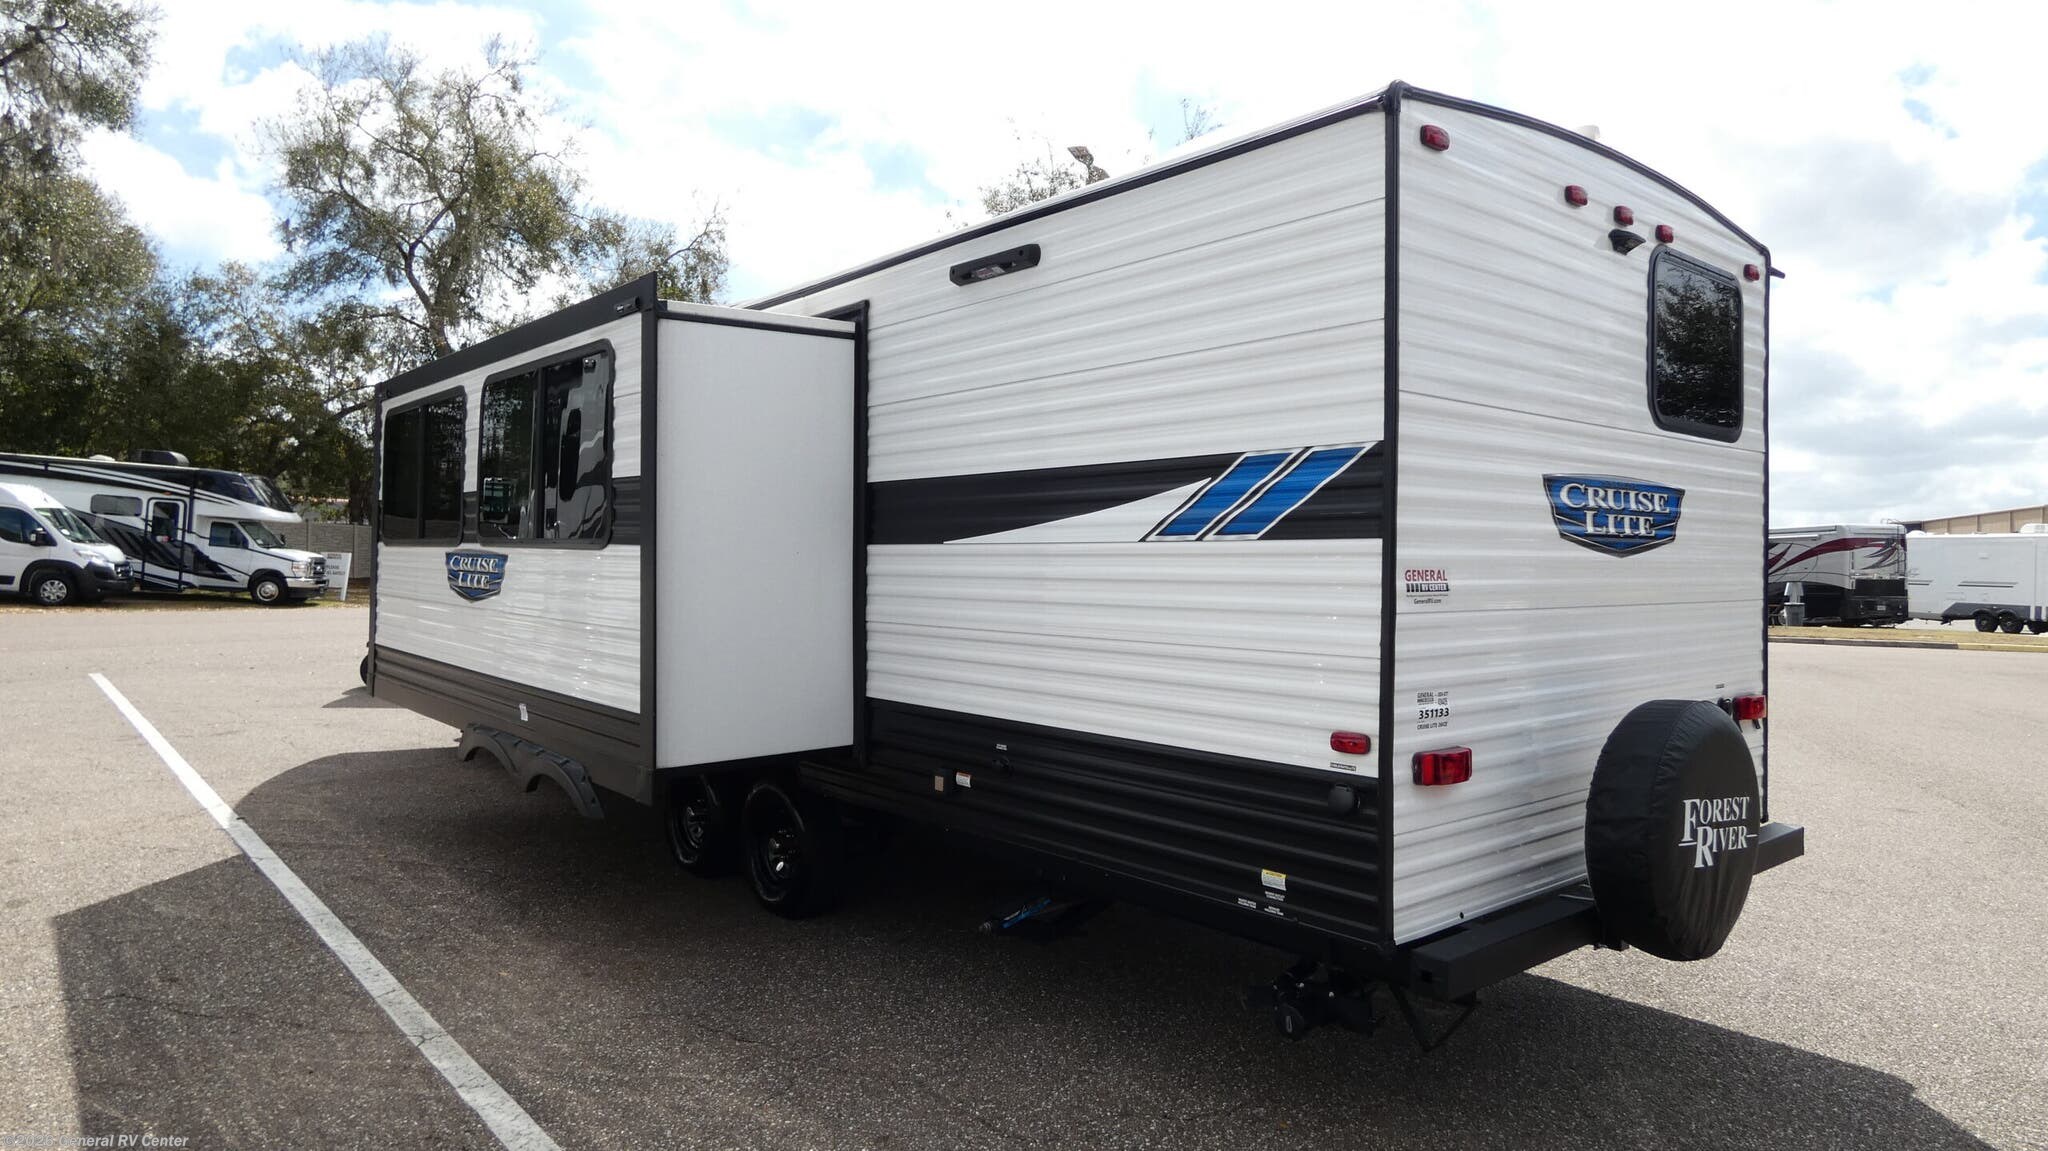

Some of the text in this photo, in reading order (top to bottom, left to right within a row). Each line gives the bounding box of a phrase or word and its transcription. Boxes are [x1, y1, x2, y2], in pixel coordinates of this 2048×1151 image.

[1559, 483, 1670, 514] CRUISE
[1584, 510, 1656, 537] LITE
[450, 555, 499, 573] CRUISE
[457, 571, 490, 589] LITE
[1404, 569, 1448, 582] GENERAL
[1418, 707, 1449, 720] 351133
[1681, 796, 1750, 842] FOREST
[1694, 825, 1748, 868] RIVER
